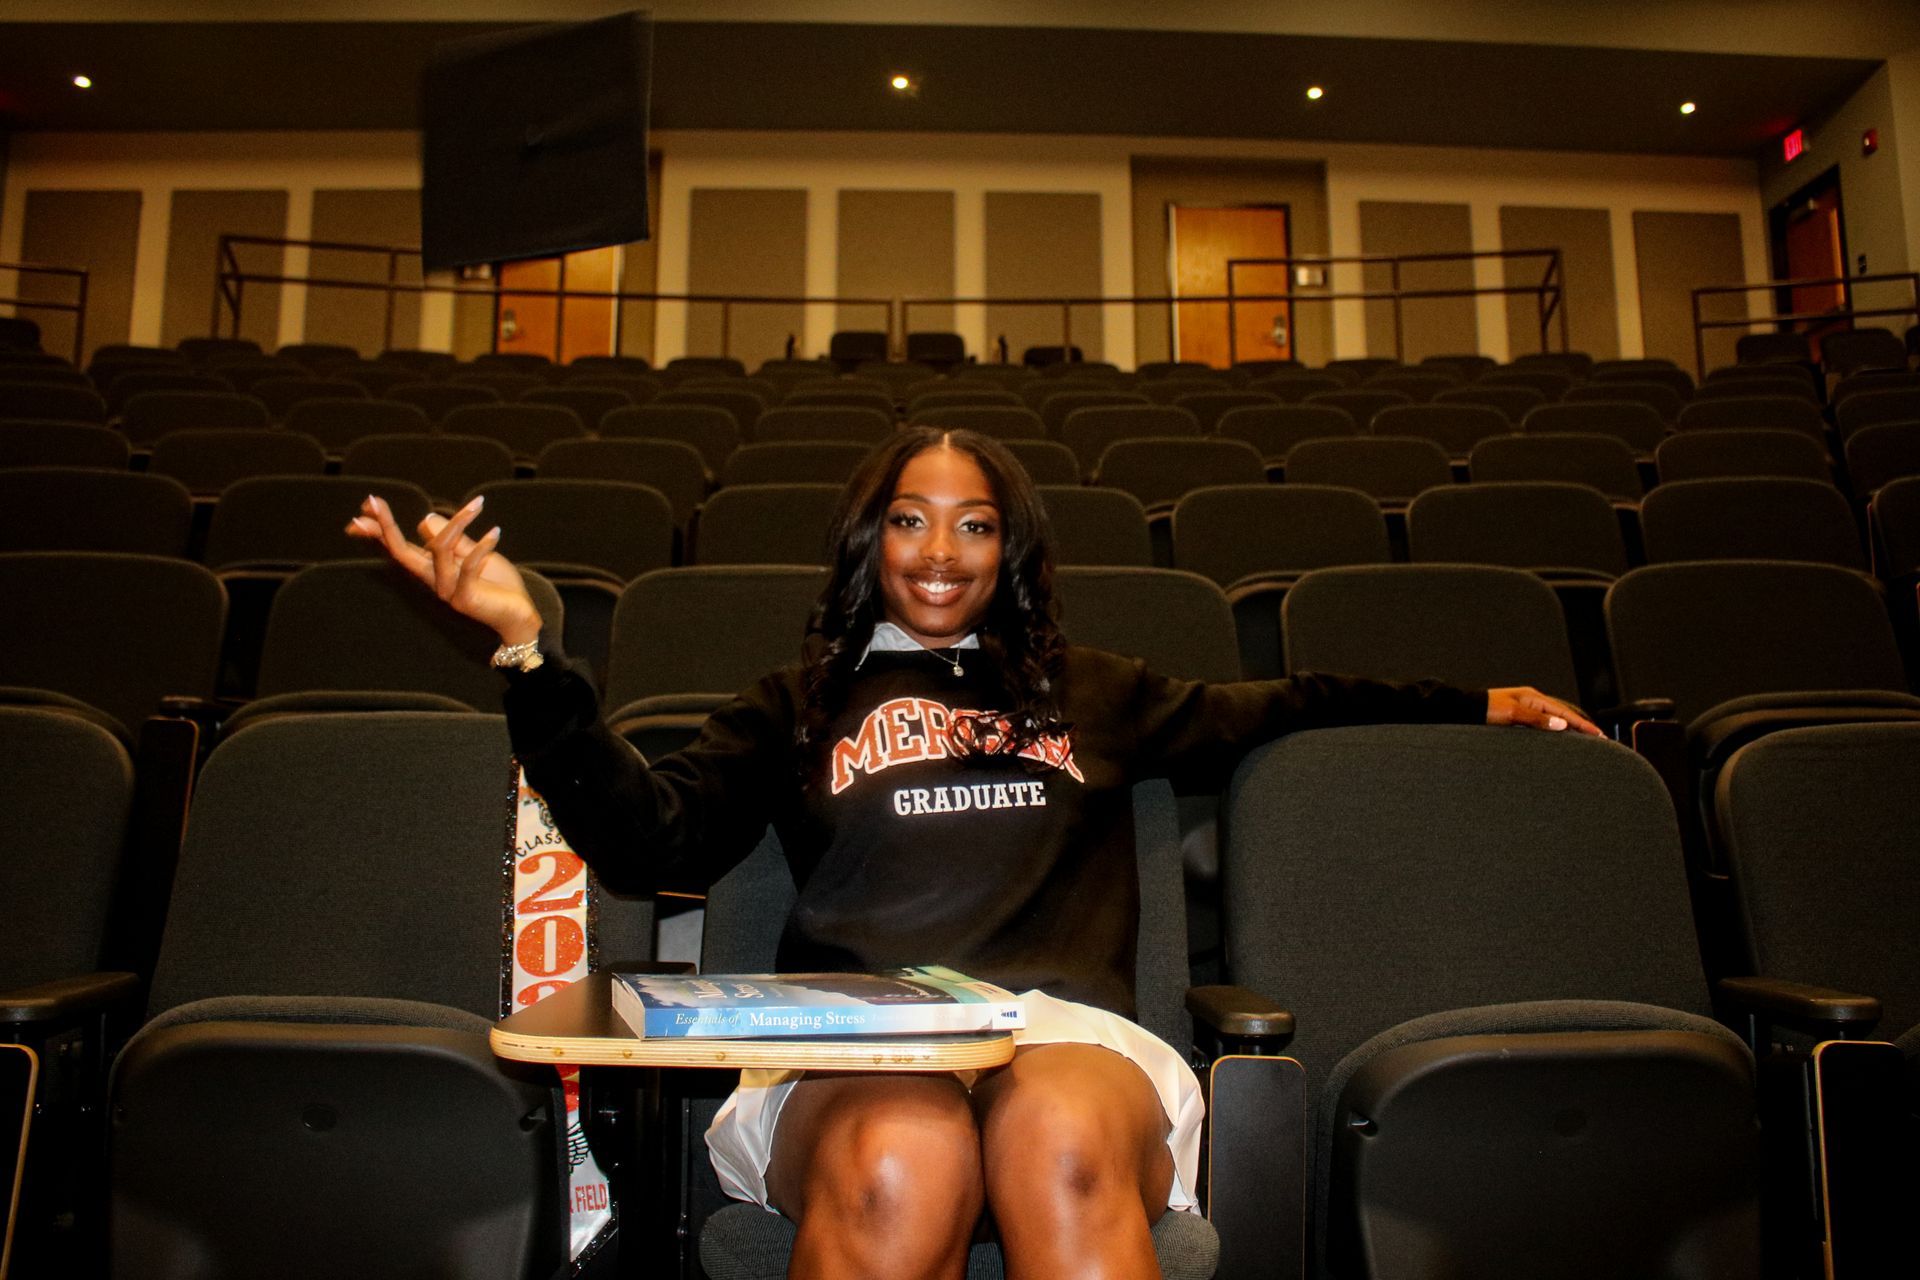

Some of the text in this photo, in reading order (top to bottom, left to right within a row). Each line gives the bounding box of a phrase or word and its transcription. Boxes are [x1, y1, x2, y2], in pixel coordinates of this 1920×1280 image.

[893, 781, 1047, 816] GRADUATE
[675, 1013, 725, 1025] Essentials
[728, 1013, 740, 1025] of
[750, 1012, 822, 1029] Managing
[826, 1011, 866, 1025] Stress
[575, 1184, 607, 1212] FIELD
